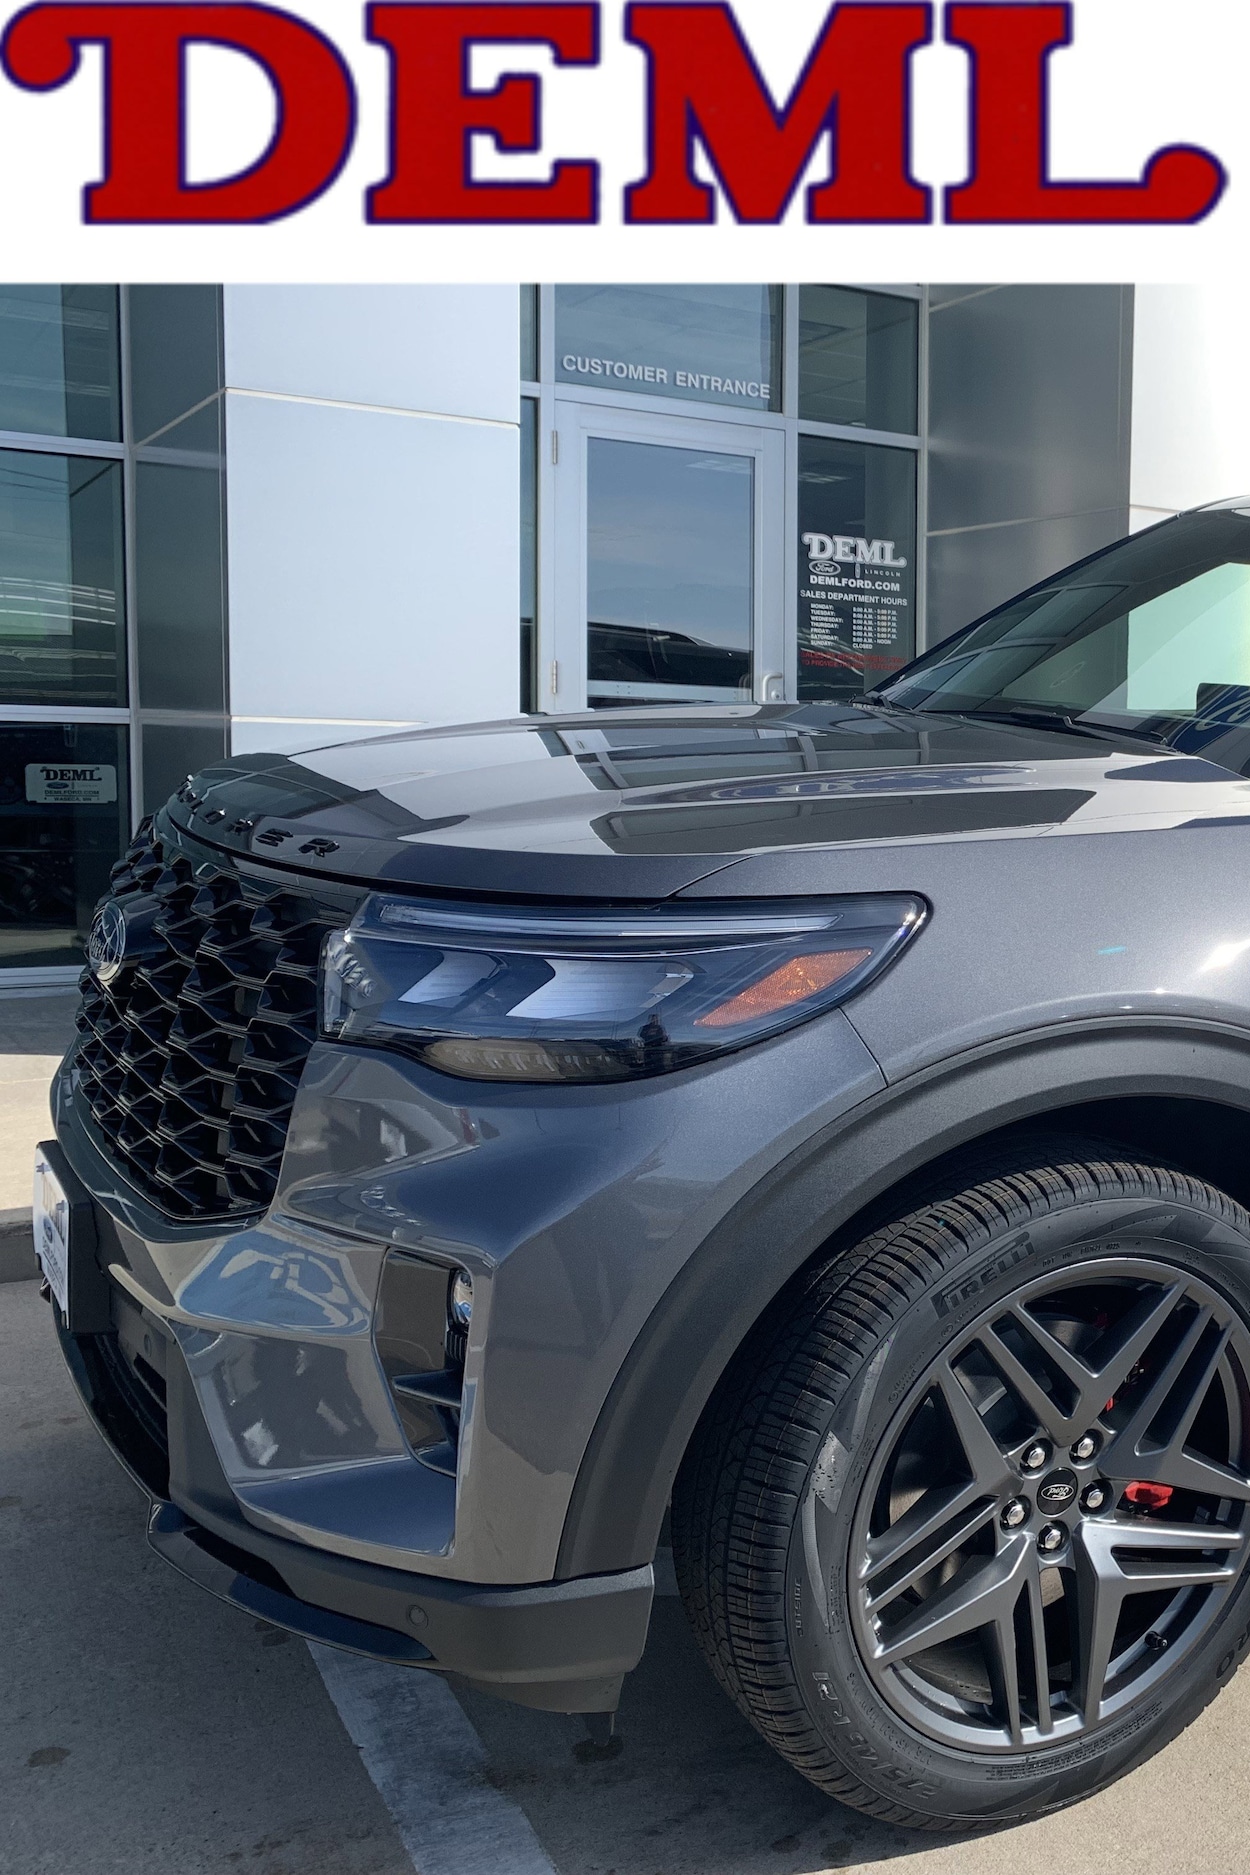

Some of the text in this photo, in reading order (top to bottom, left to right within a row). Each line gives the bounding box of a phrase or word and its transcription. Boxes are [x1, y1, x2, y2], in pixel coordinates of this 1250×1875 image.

[563, 355, 771, 399] CUSTOMER ENTRANCE
[801, 532, 907, 568] DEML
[815, 561, 835, 574] Ford
[865, 568, 901, 577] LINCOLN
[809, 575, 900, 592] DEMLFORD.COM
[800, 590, 908, 606] SALES DEPARTMENT HOURS
[40, 769, 102, 781] DEML
[930, 1231, 1035, 1320] PIRELLI
